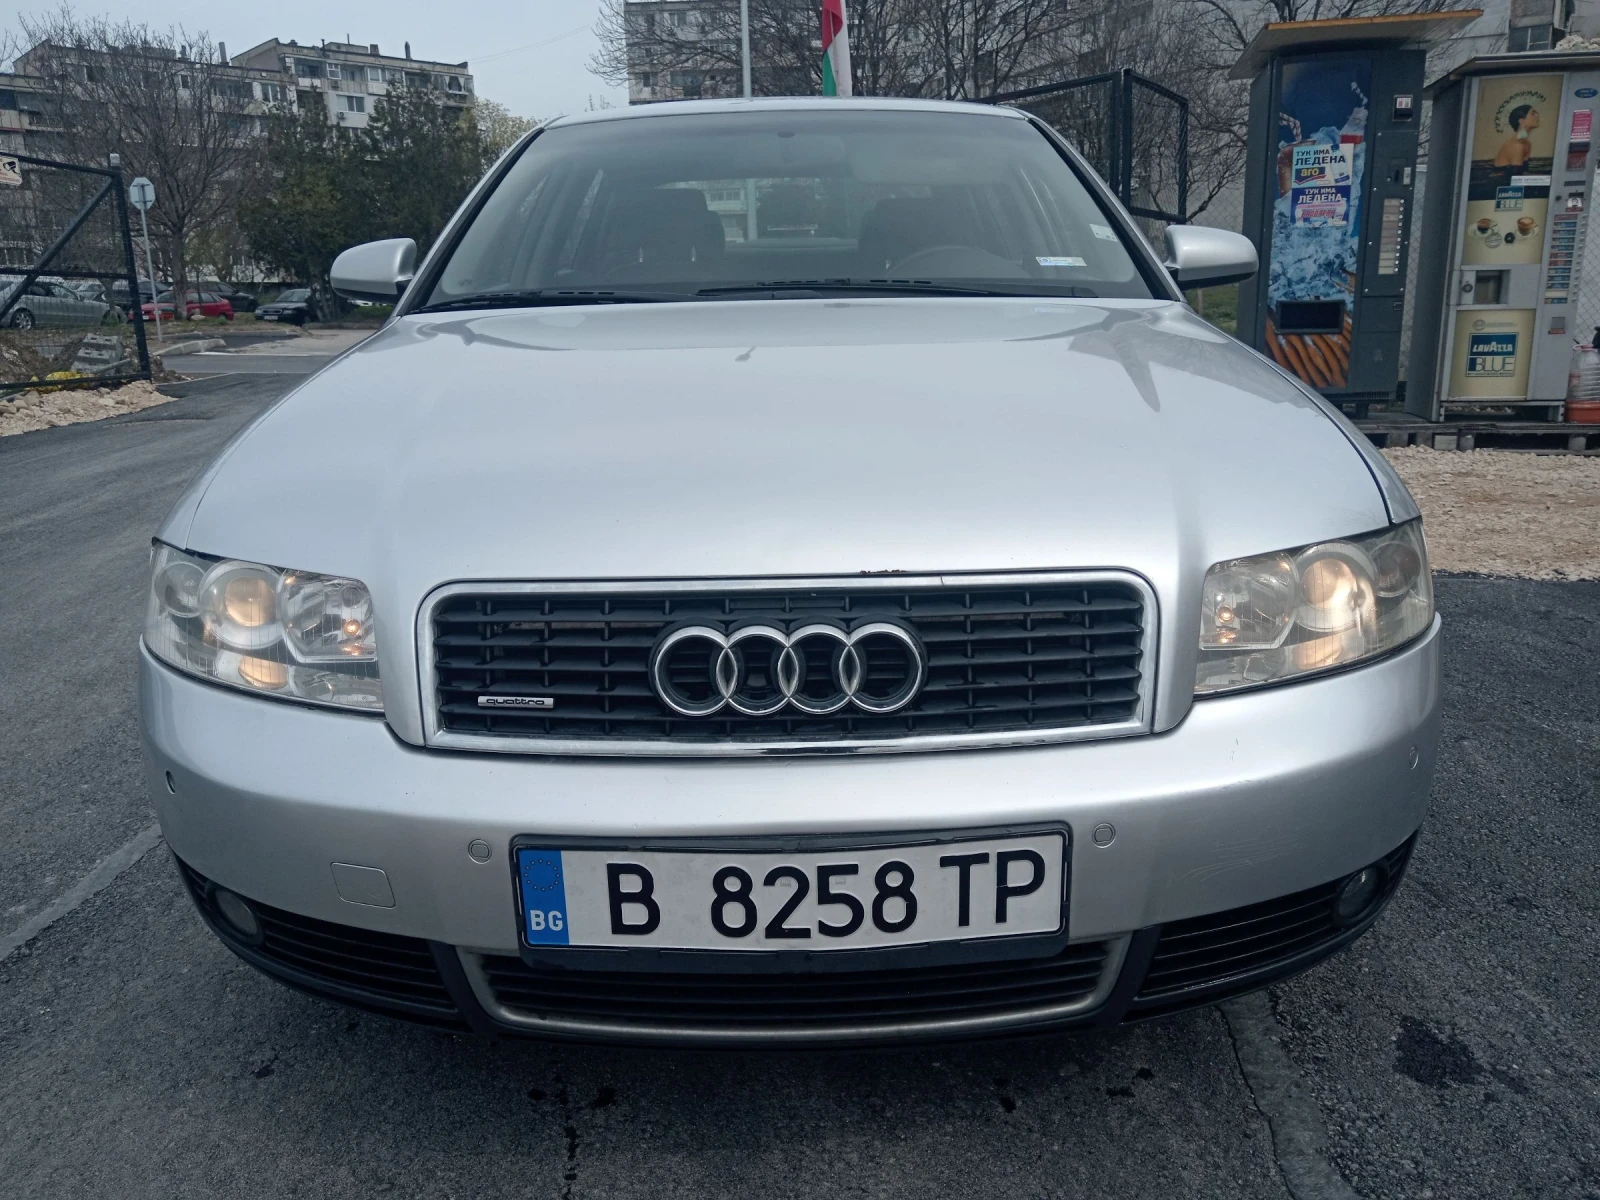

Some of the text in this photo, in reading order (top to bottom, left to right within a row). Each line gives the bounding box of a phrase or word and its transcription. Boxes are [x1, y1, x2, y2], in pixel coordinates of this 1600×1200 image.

[1295, 156, 1345, 166] ЛЕДЕНА
[1301, 167, 1319, 176] aro
[1298, 193, 1342, 203] ЛЕДЕНА
[1472, 341, 1513, 352] LAVAZZA
[1468, 356, 1515, 372] BLUE
[606, 849, 1046, 939] B 8258 TP
[530, 909, 563, 932] BG
